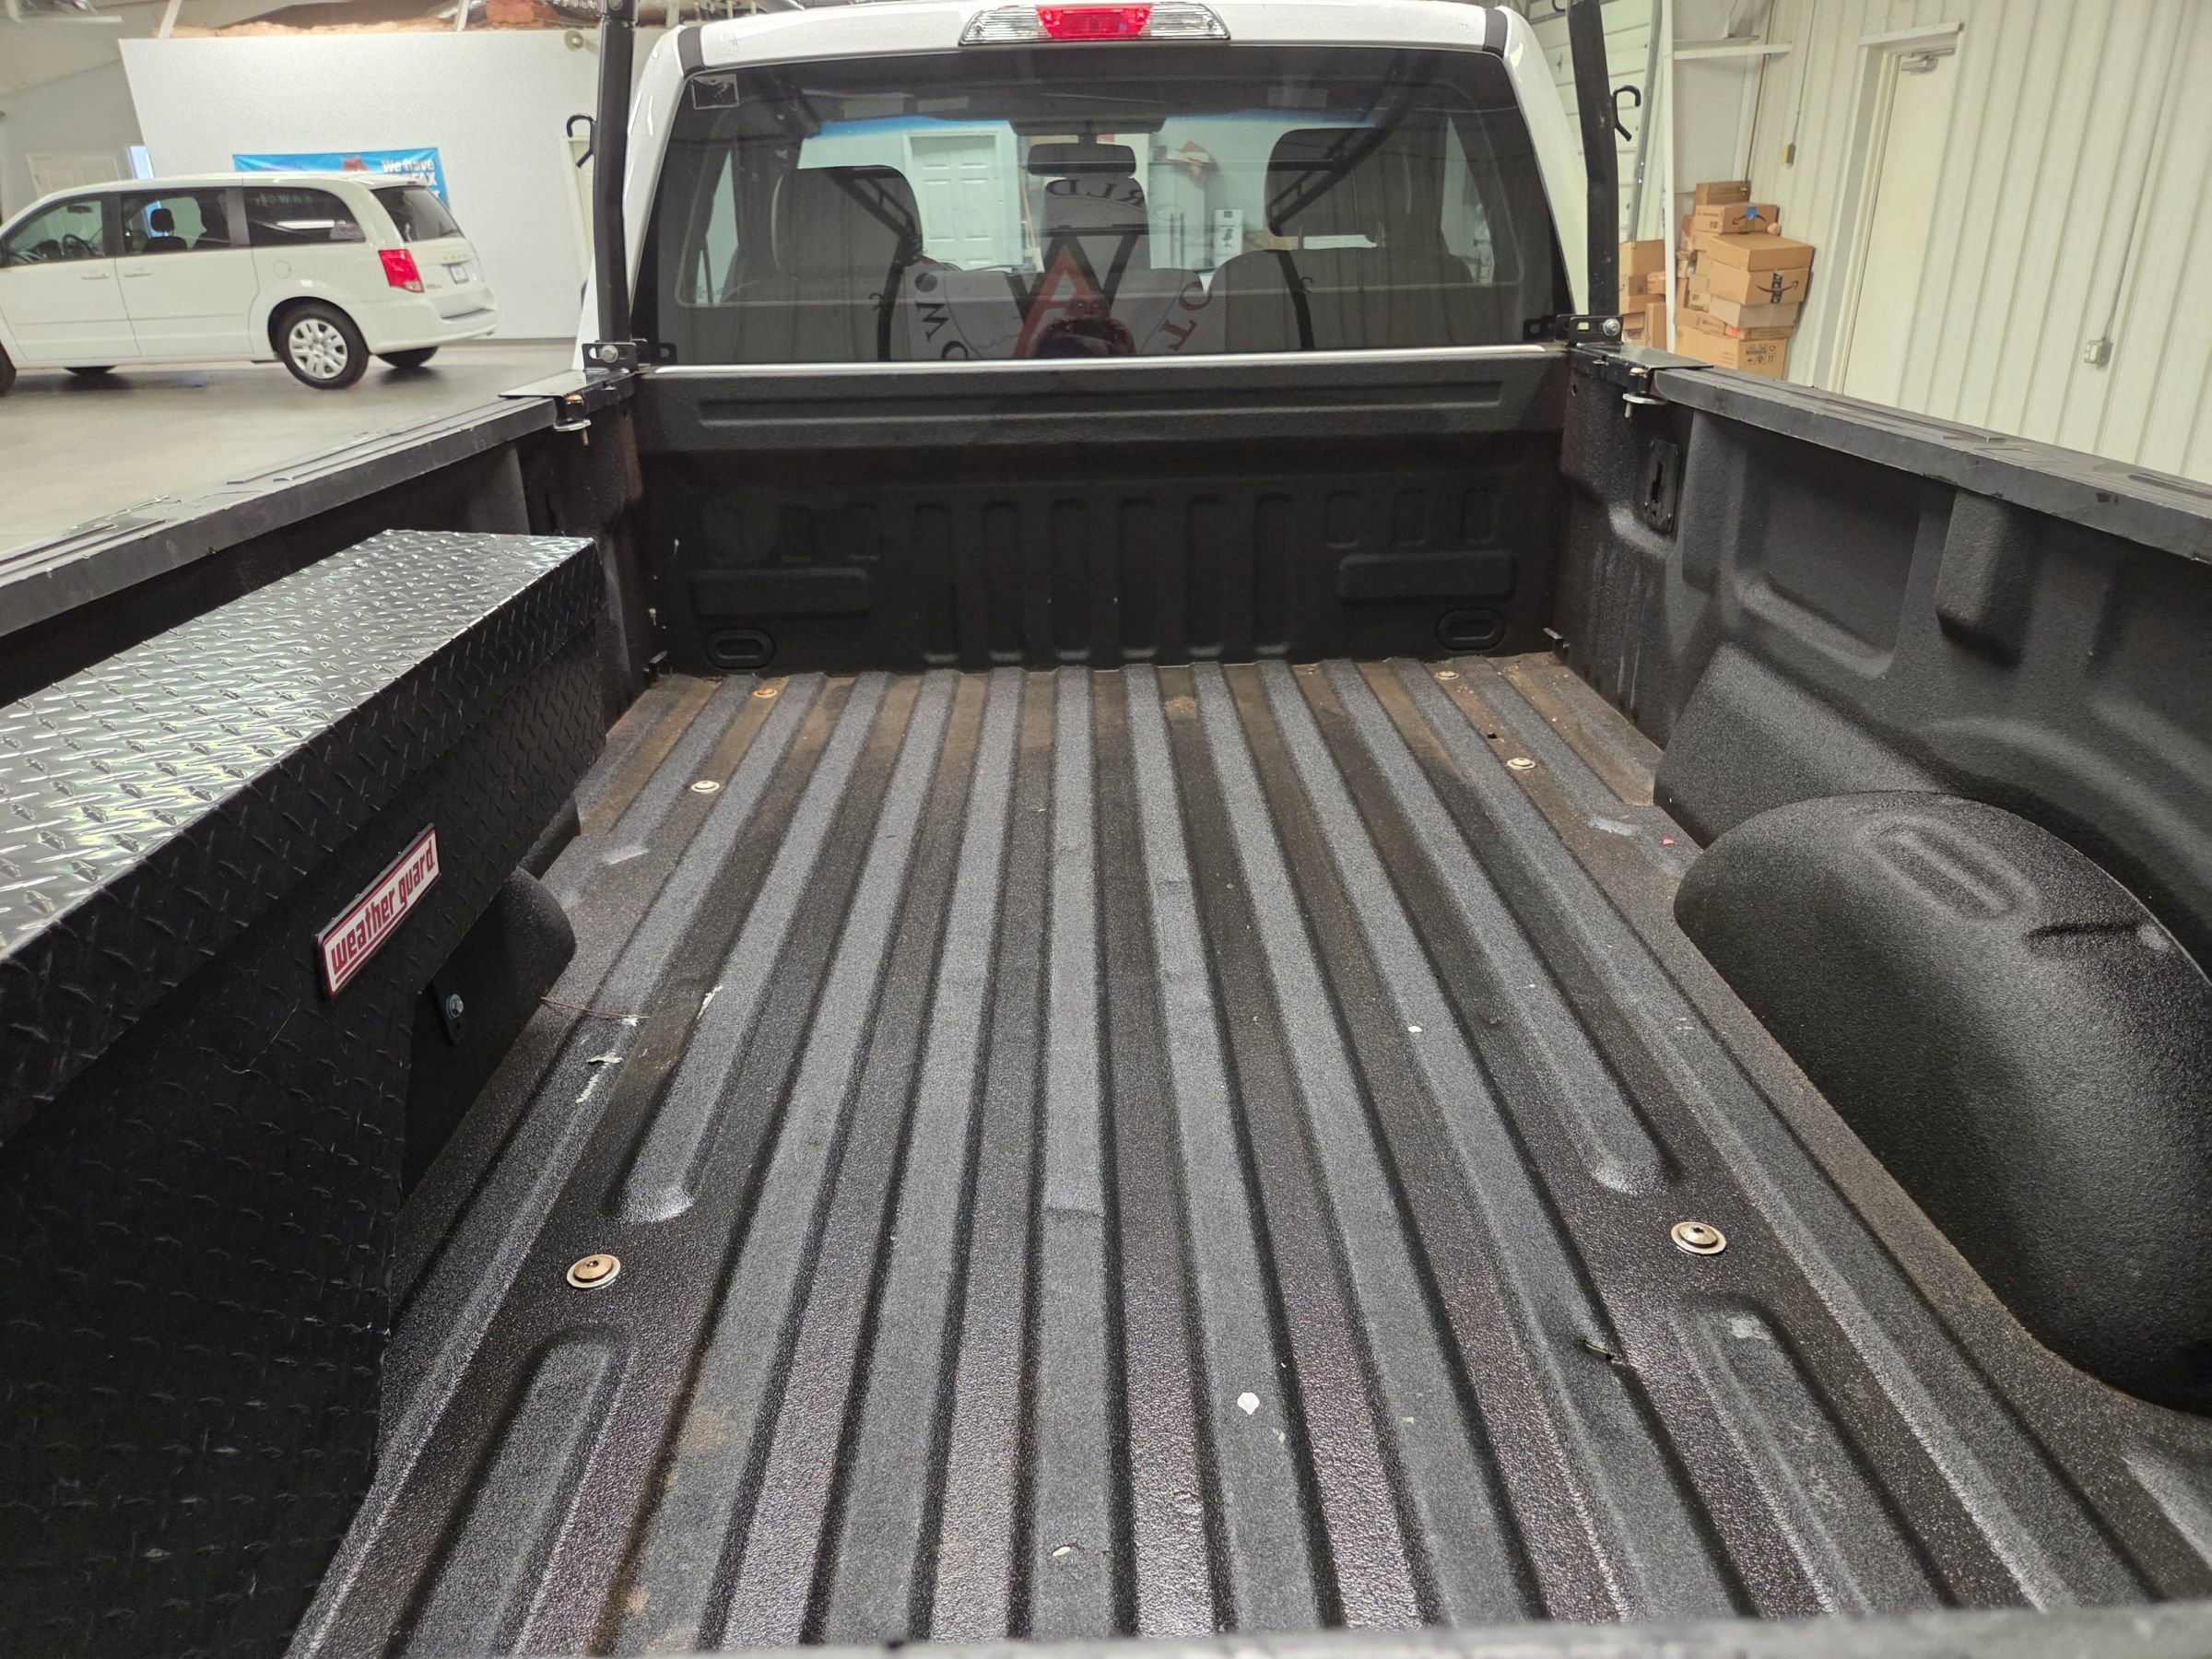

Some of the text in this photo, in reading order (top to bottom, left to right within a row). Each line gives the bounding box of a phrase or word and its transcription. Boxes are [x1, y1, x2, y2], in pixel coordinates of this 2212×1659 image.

[383, 159, 435, 172] We have
[330, 840, 435, 975] weather guard
